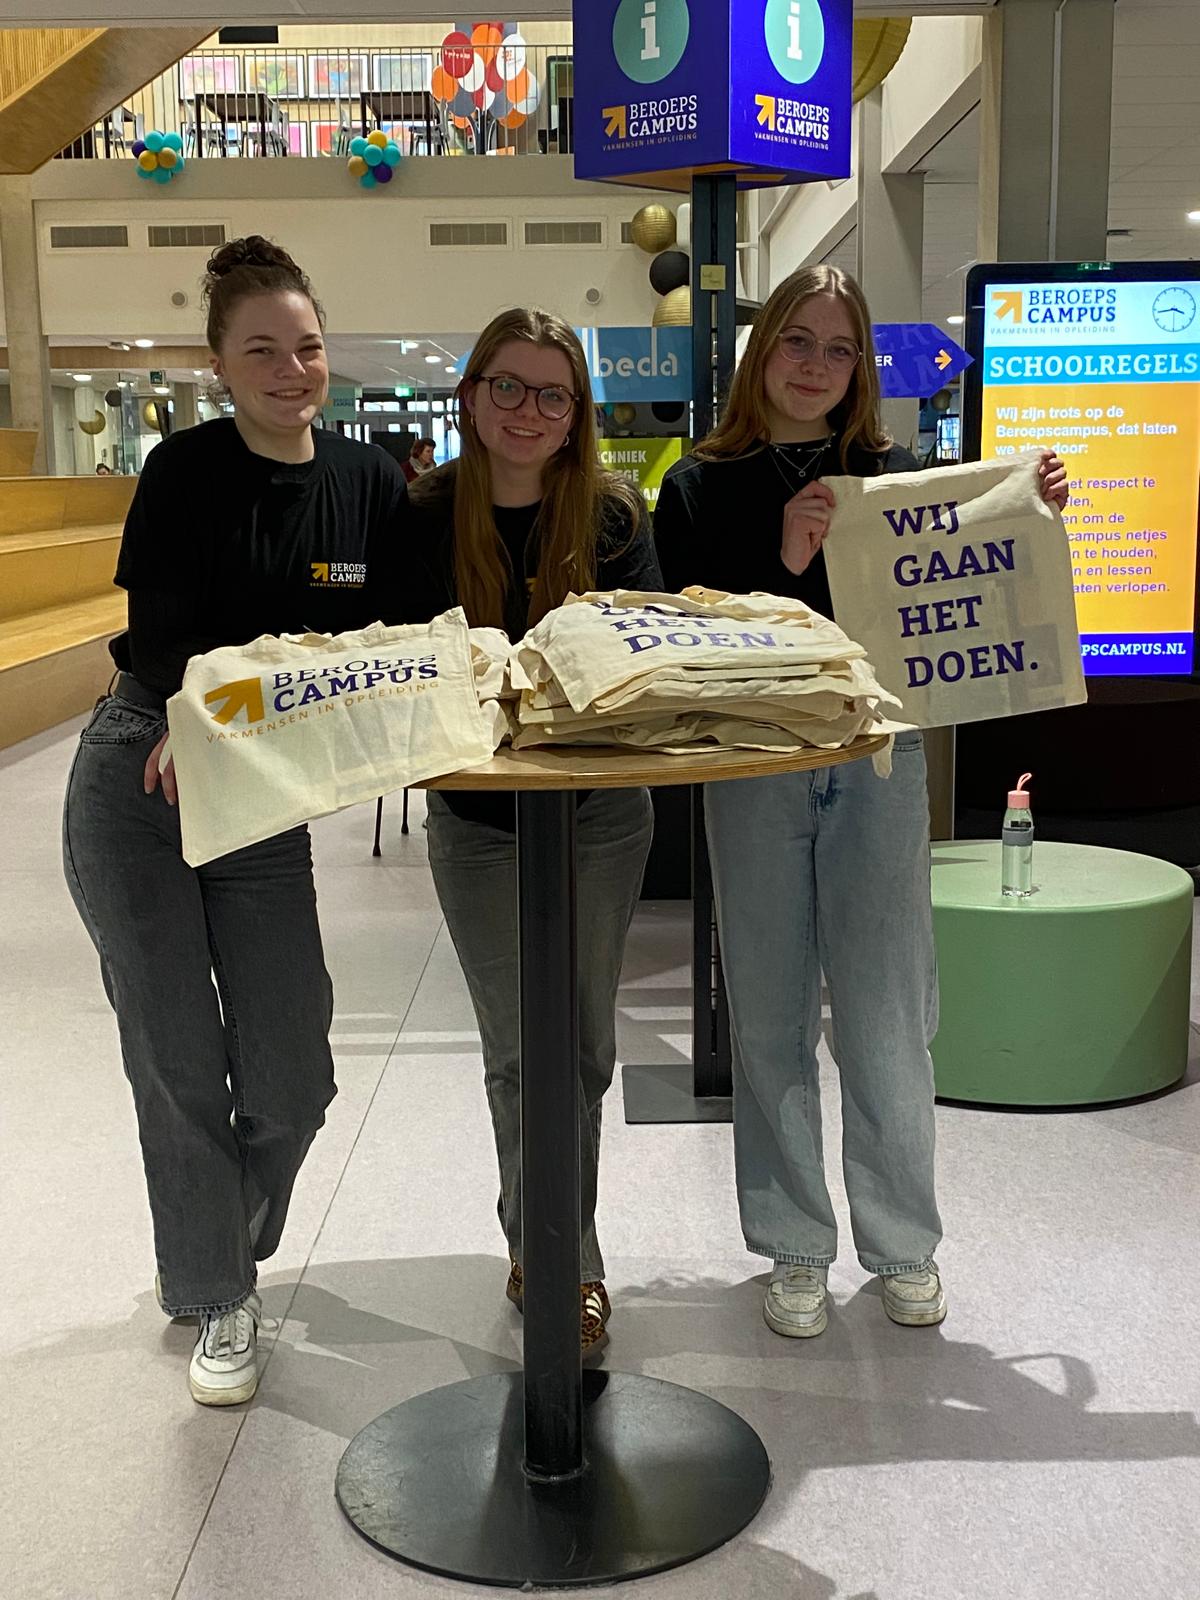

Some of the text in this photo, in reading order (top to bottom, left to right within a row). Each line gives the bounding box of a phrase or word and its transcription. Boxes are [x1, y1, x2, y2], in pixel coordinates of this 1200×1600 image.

[629, 95, 697, 120] BEROEPS
[777, 98, 829, 123] BEROEPS
[629, 113, 697, 137] CAMPUS
[776, 117, 829, 141] CAMPUS
[1028, 288, 1116, 306] BEROEPS
[1027, 307, 1116, 323] CAMPUS
[990, 325, 1116, 335] VAKMENSEN IN OPLEIDING
[875, 355, 893, 367] ER
[989, 353, 1198, 378] SCHOOLREGELS
[996, 406, 1124, 422] Wij zijn trots op de
[995, 422, 1177, 439] Beroepscampus, dat laten
[597, 450, 647, 464] CHNIEK
[995, 444, 1014, 455] we
[1052, 442, 1088, 454] door:
[1068, 477, 1156, 491] et respect te
[883, 501, 960, 537] WIJ
[1082, 514, 1104, 524] om
[1108, 512, 1125, 523] de
[1067, 529, 1168, 544] campus netjes
[1085, 548, 1097, 559] te
[1102, 547, 1158, 560] houden,
[893, 539, 1016, 587] GAAN
[1086, 567, 1102, 576] en
[1107, 564, 1152, 576] lessen
[1073, 581, 1171, 595] aten verlopen.
[610, 618, 713, 632] HET
[898, 595, 983, 638] HET
[623, 632, 795, 654] DOEN.
[1080, 643, 1187, 657] PSCAMPUS.NL
[272, 654, 437, 690] BEROEPS
[904, 641, 1039, 689] DOEN.
[273, 664, 439, 713] CAMPUS
[206, 681, 440, 744] VAKMENSEN IN OPLEIDING
